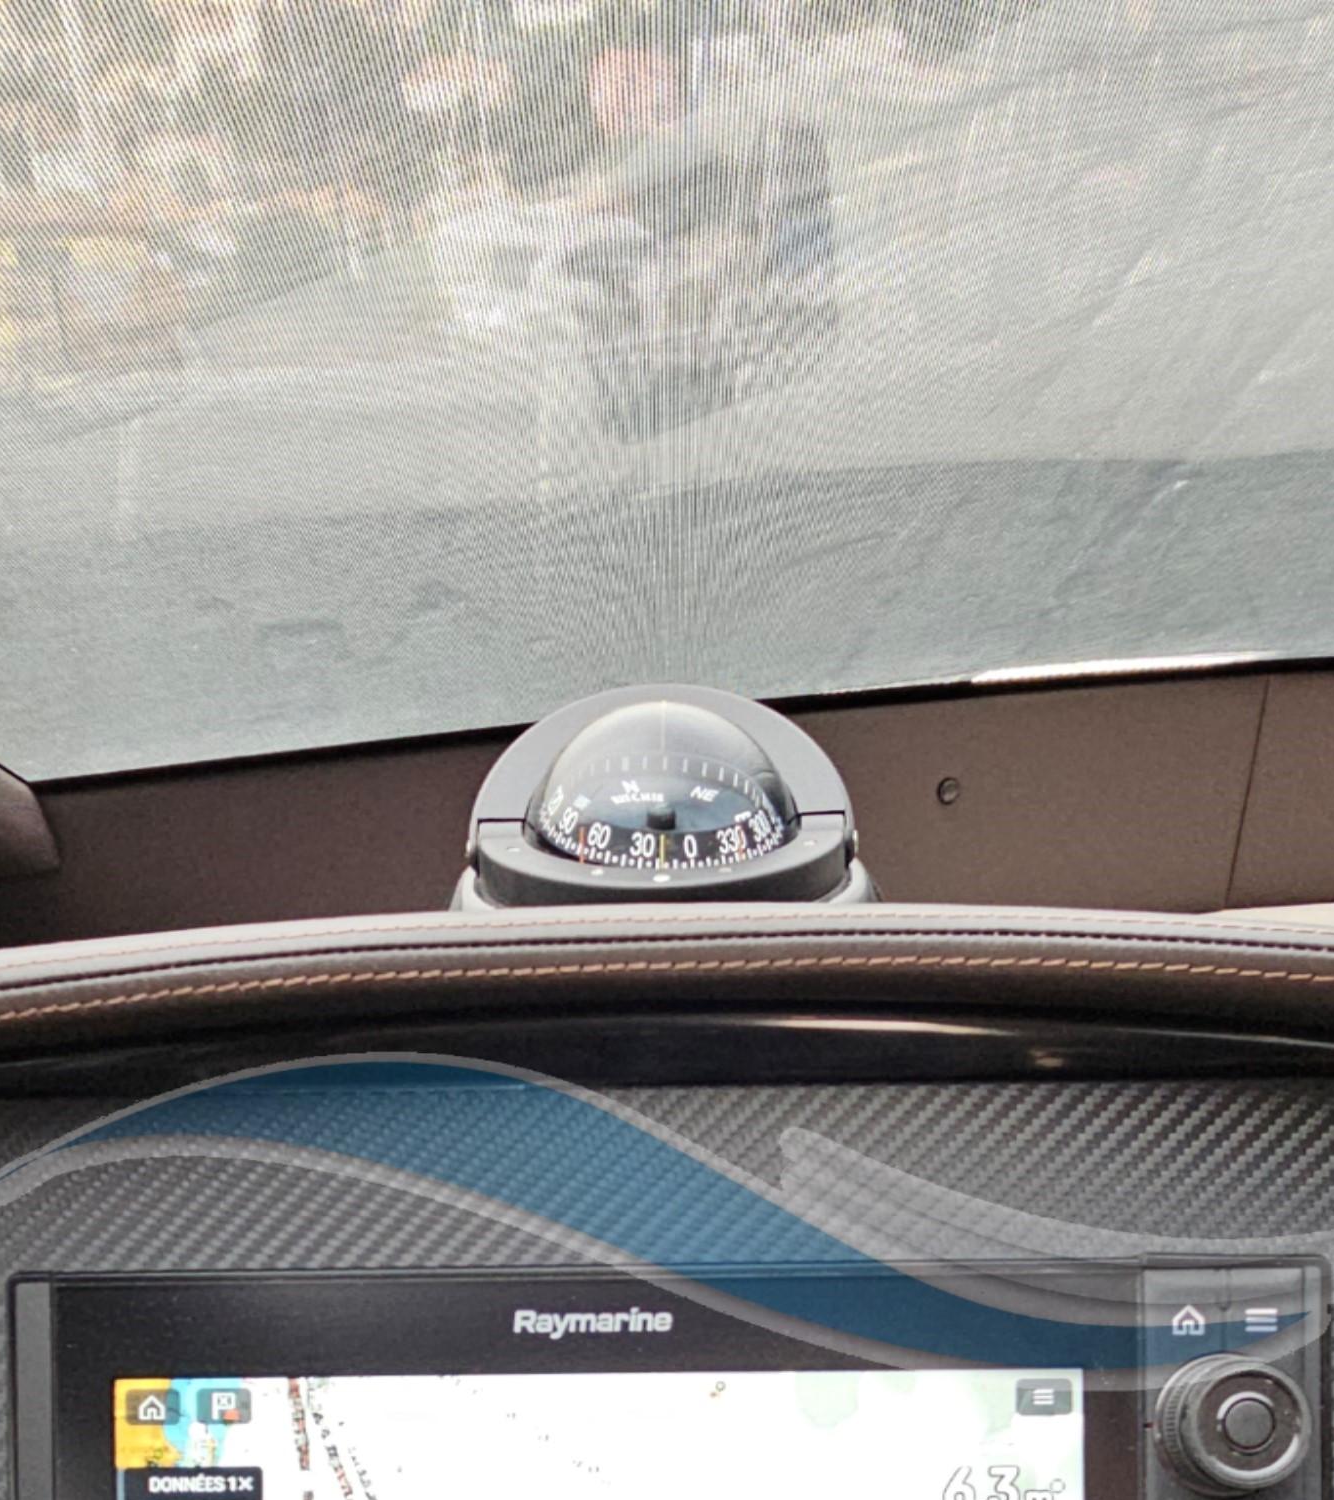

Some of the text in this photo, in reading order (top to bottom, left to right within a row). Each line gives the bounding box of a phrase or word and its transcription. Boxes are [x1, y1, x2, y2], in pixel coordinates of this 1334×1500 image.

[587, 821, 611, 849] 60
[629, 831, 656, 858] 30
[683, 834, 698, 859] 0
[716, 825, 747, 854] 330
[513, 1307, 673, 1340] Raymarine
[148, 1472, 227, 1493] DONNÉES
